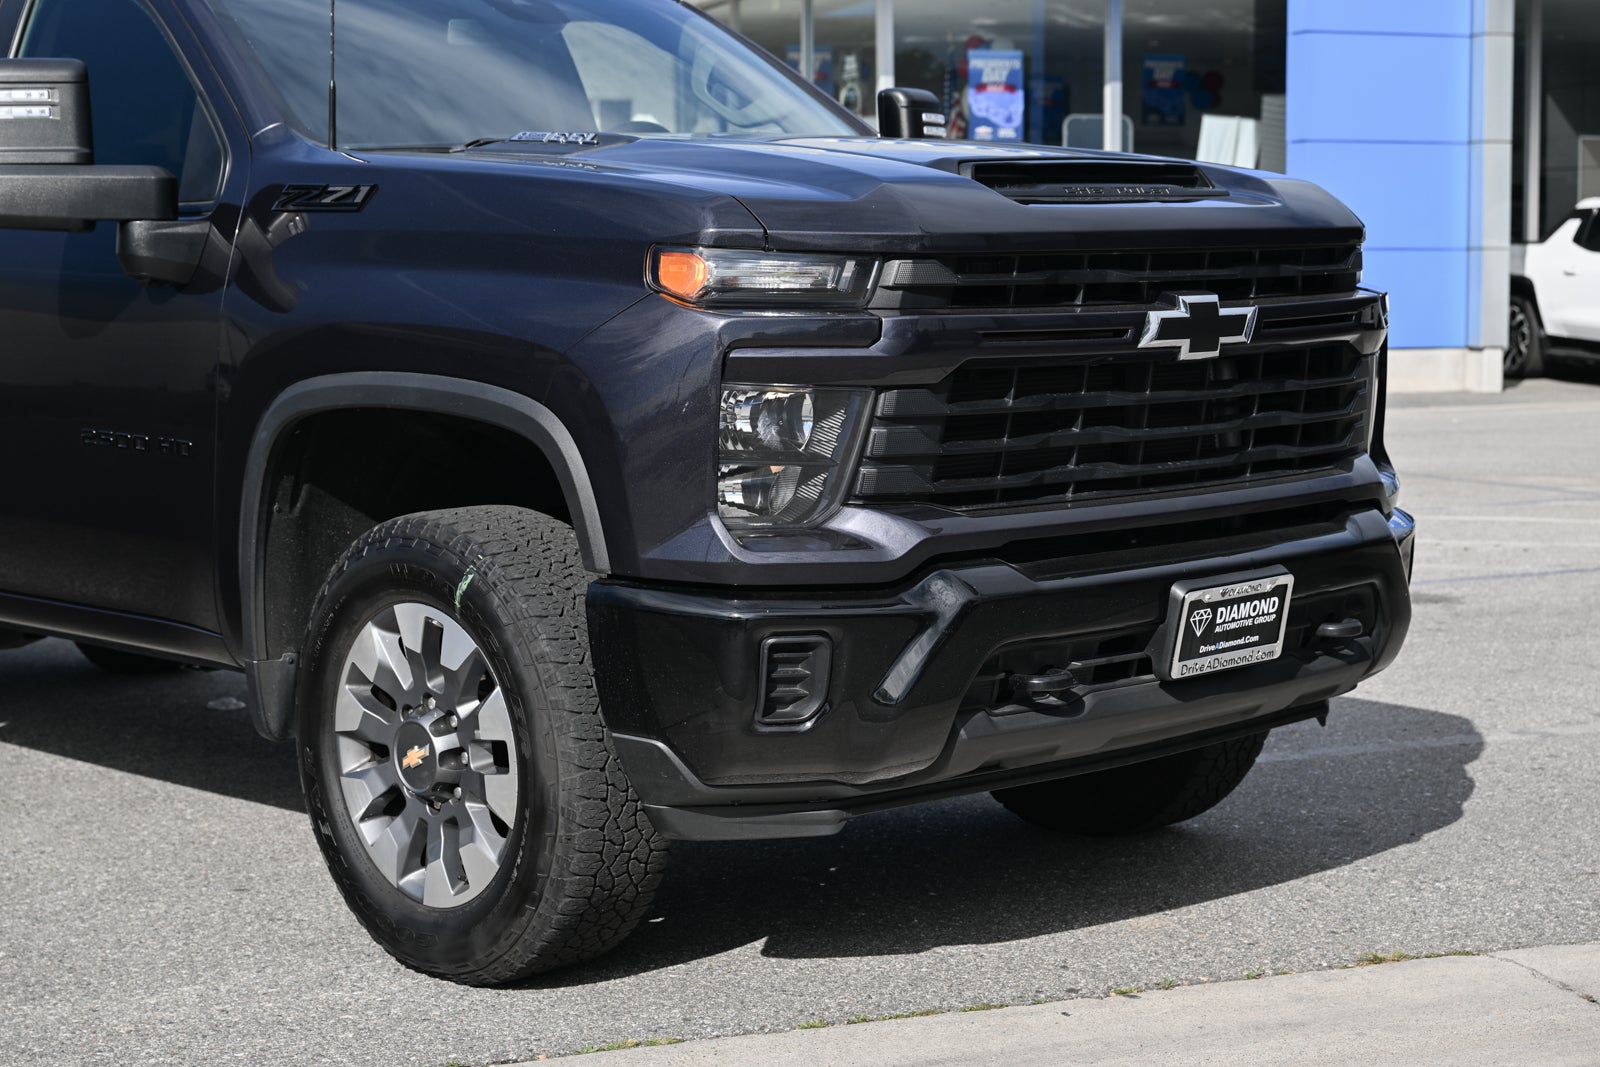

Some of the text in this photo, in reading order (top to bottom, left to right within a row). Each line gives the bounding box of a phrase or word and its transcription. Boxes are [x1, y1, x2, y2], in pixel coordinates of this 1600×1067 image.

[271, 184, 379, 212] Z71
[80, 427, 149, 451] 2500
[1214, 613, 1276, 633] AUTOMOTIVE GROUP
[1216, 597, 1279, 624] DIAMOND
